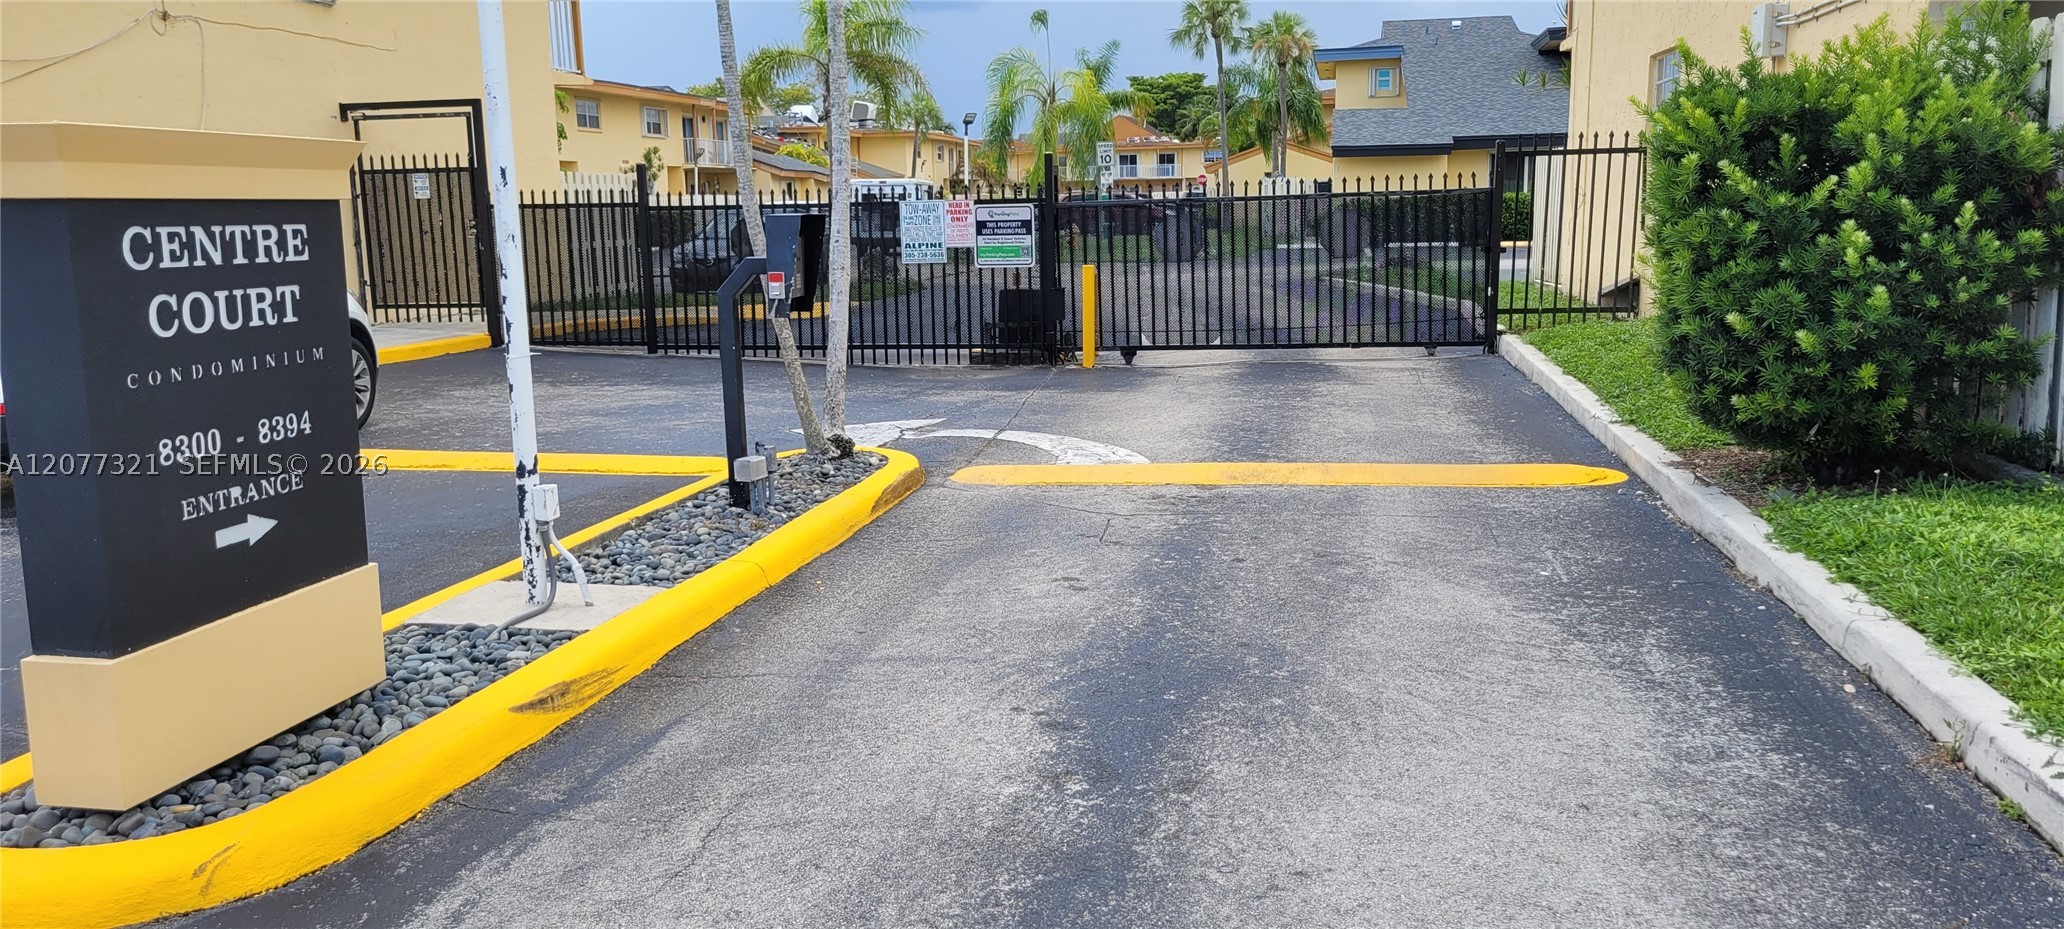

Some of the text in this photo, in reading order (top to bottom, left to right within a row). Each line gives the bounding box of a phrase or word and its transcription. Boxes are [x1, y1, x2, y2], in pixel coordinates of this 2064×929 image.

[1100, 154, 1112, 164] 10
[904, 203, 939, 214] TOW-AWAY
[914, 215, 931, 225] ZONE
[946, 208, 973, 216] PARKING
[121, 223, 311, 272] CENTRE
[148, 284, 301, 339] COURT
[126, 346, 326, 390] CONDOMINIUM
[158, 427, 223, 468] 8300
[258, 410, 313, 446] 8394
[181, 469, 305, 522] ENTRANCE
